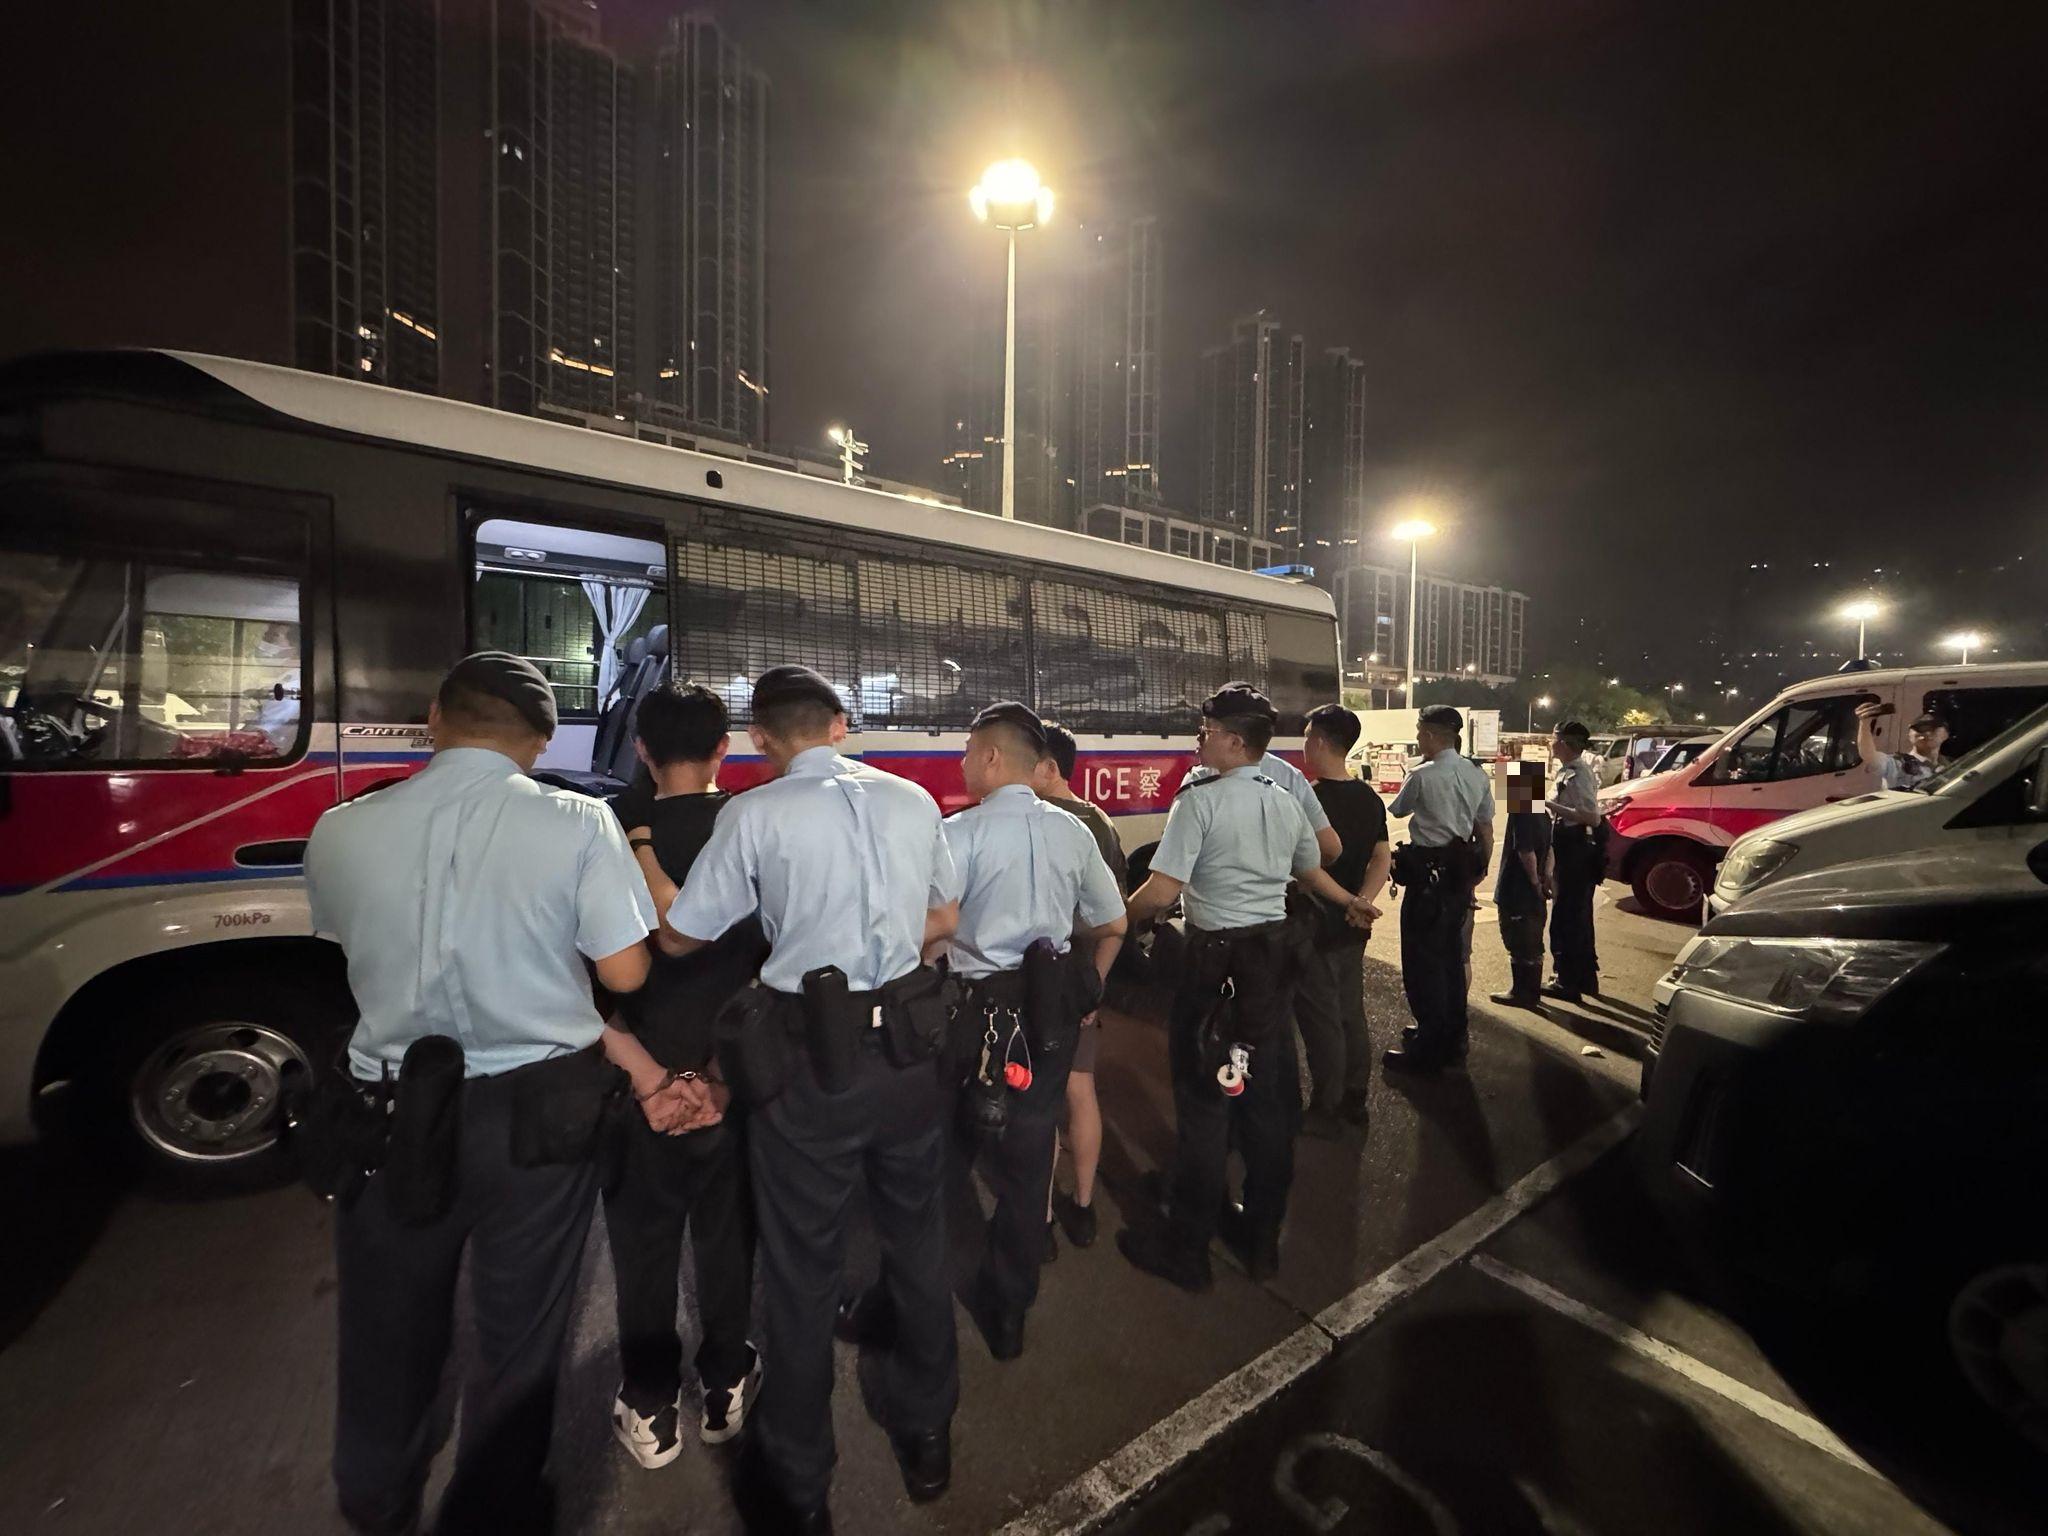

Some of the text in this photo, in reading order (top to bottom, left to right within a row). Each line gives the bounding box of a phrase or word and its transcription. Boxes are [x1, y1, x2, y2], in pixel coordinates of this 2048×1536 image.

[1084, 766, 1162, 801] ICE 察
[213, 912, 272, 928] 700kPa
